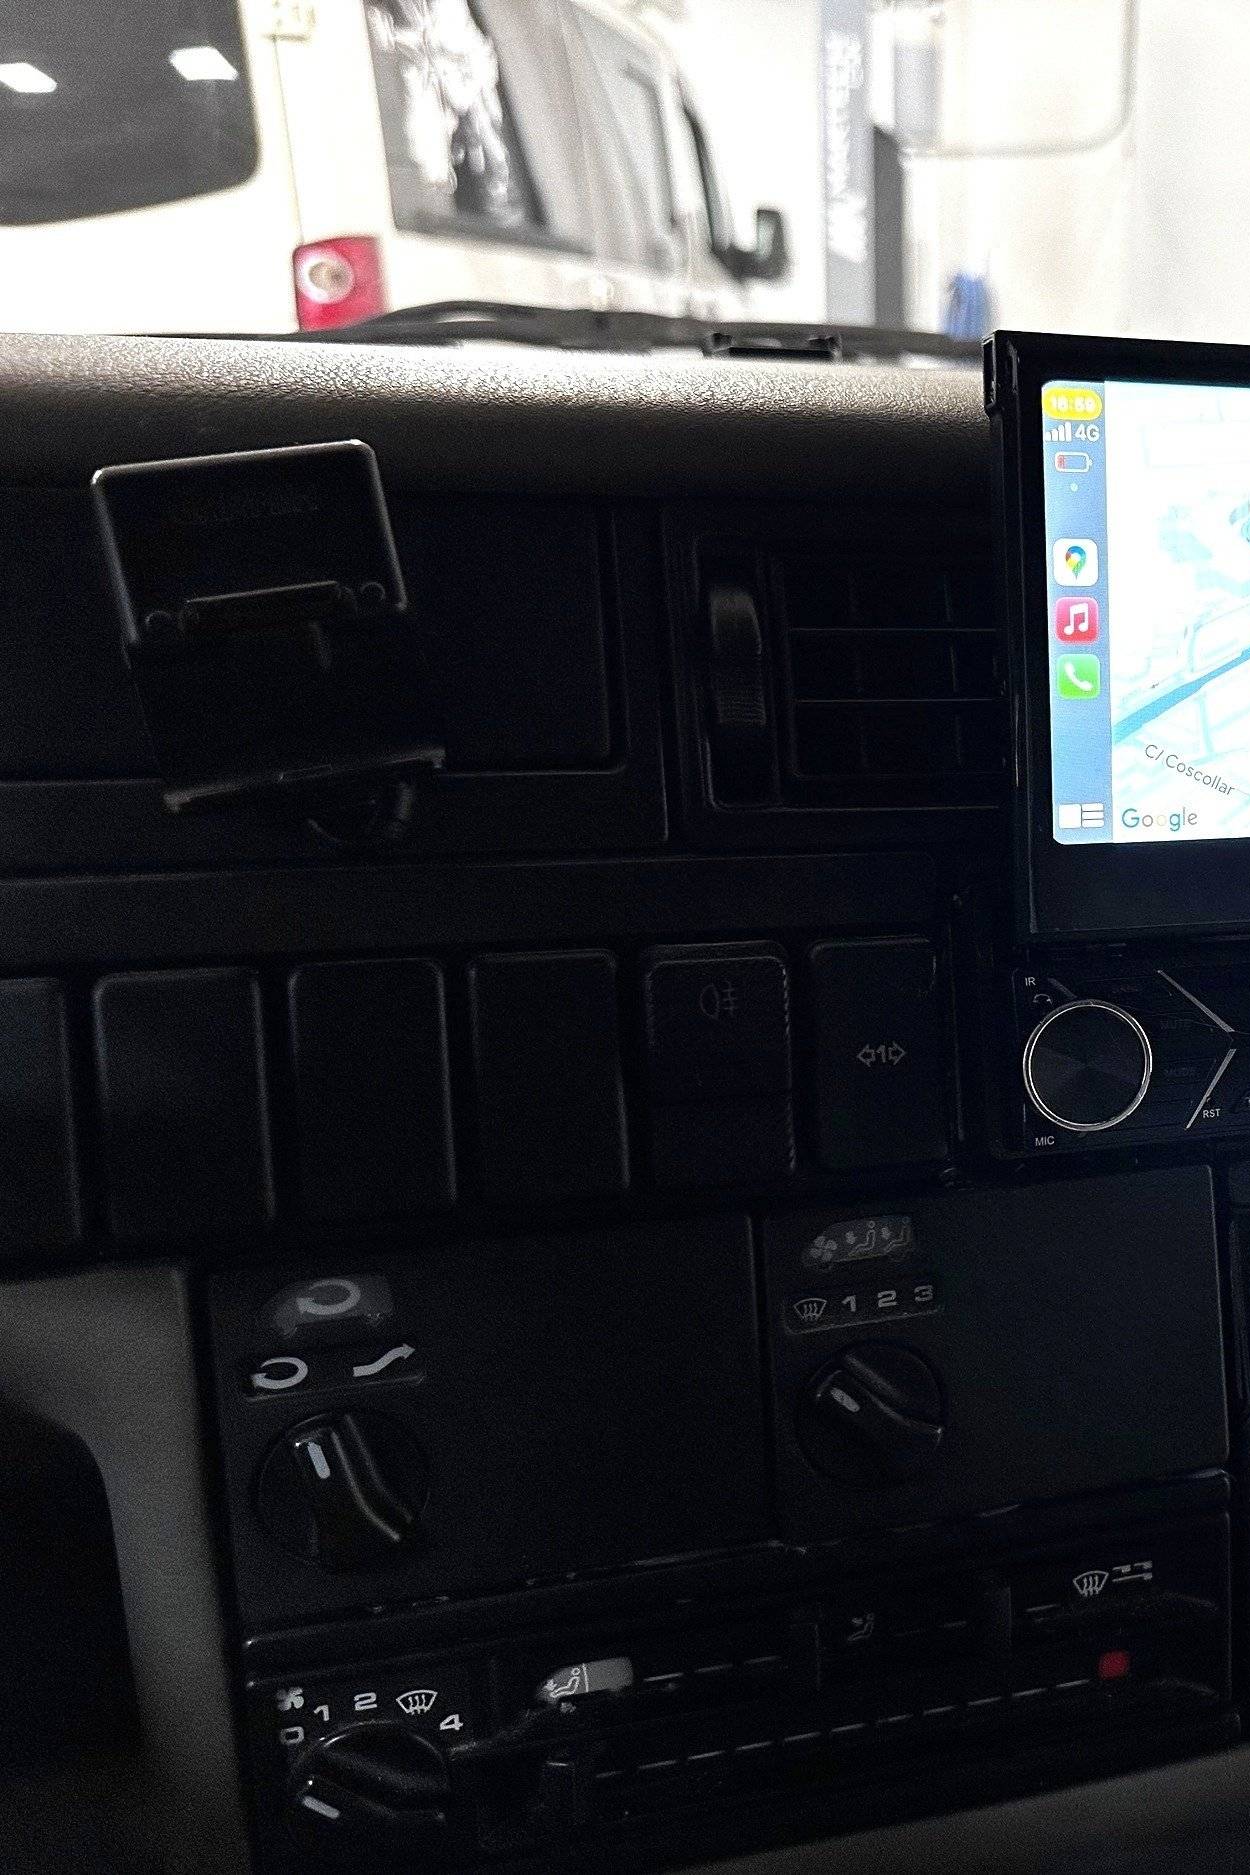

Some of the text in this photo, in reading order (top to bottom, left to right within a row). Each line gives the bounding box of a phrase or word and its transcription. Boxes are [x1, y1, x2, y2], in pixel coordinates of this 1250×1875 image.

[1075, 424, 1100, 443] 4G
[1144, 743, 1236, 796] C/ Coscollar
[1121, 807, 1198, 832] Google
[1024, 976, 1036, 987] IR
[1202, 1108, 1221, 1119] RST
[1034, 1136, 1055, 1147] MIC
[842, 1285, 933, 1312] 1 2 3
[313, 1692, 464, 1731] 1 2 4
[279, 1726, 305, 1746] 0
